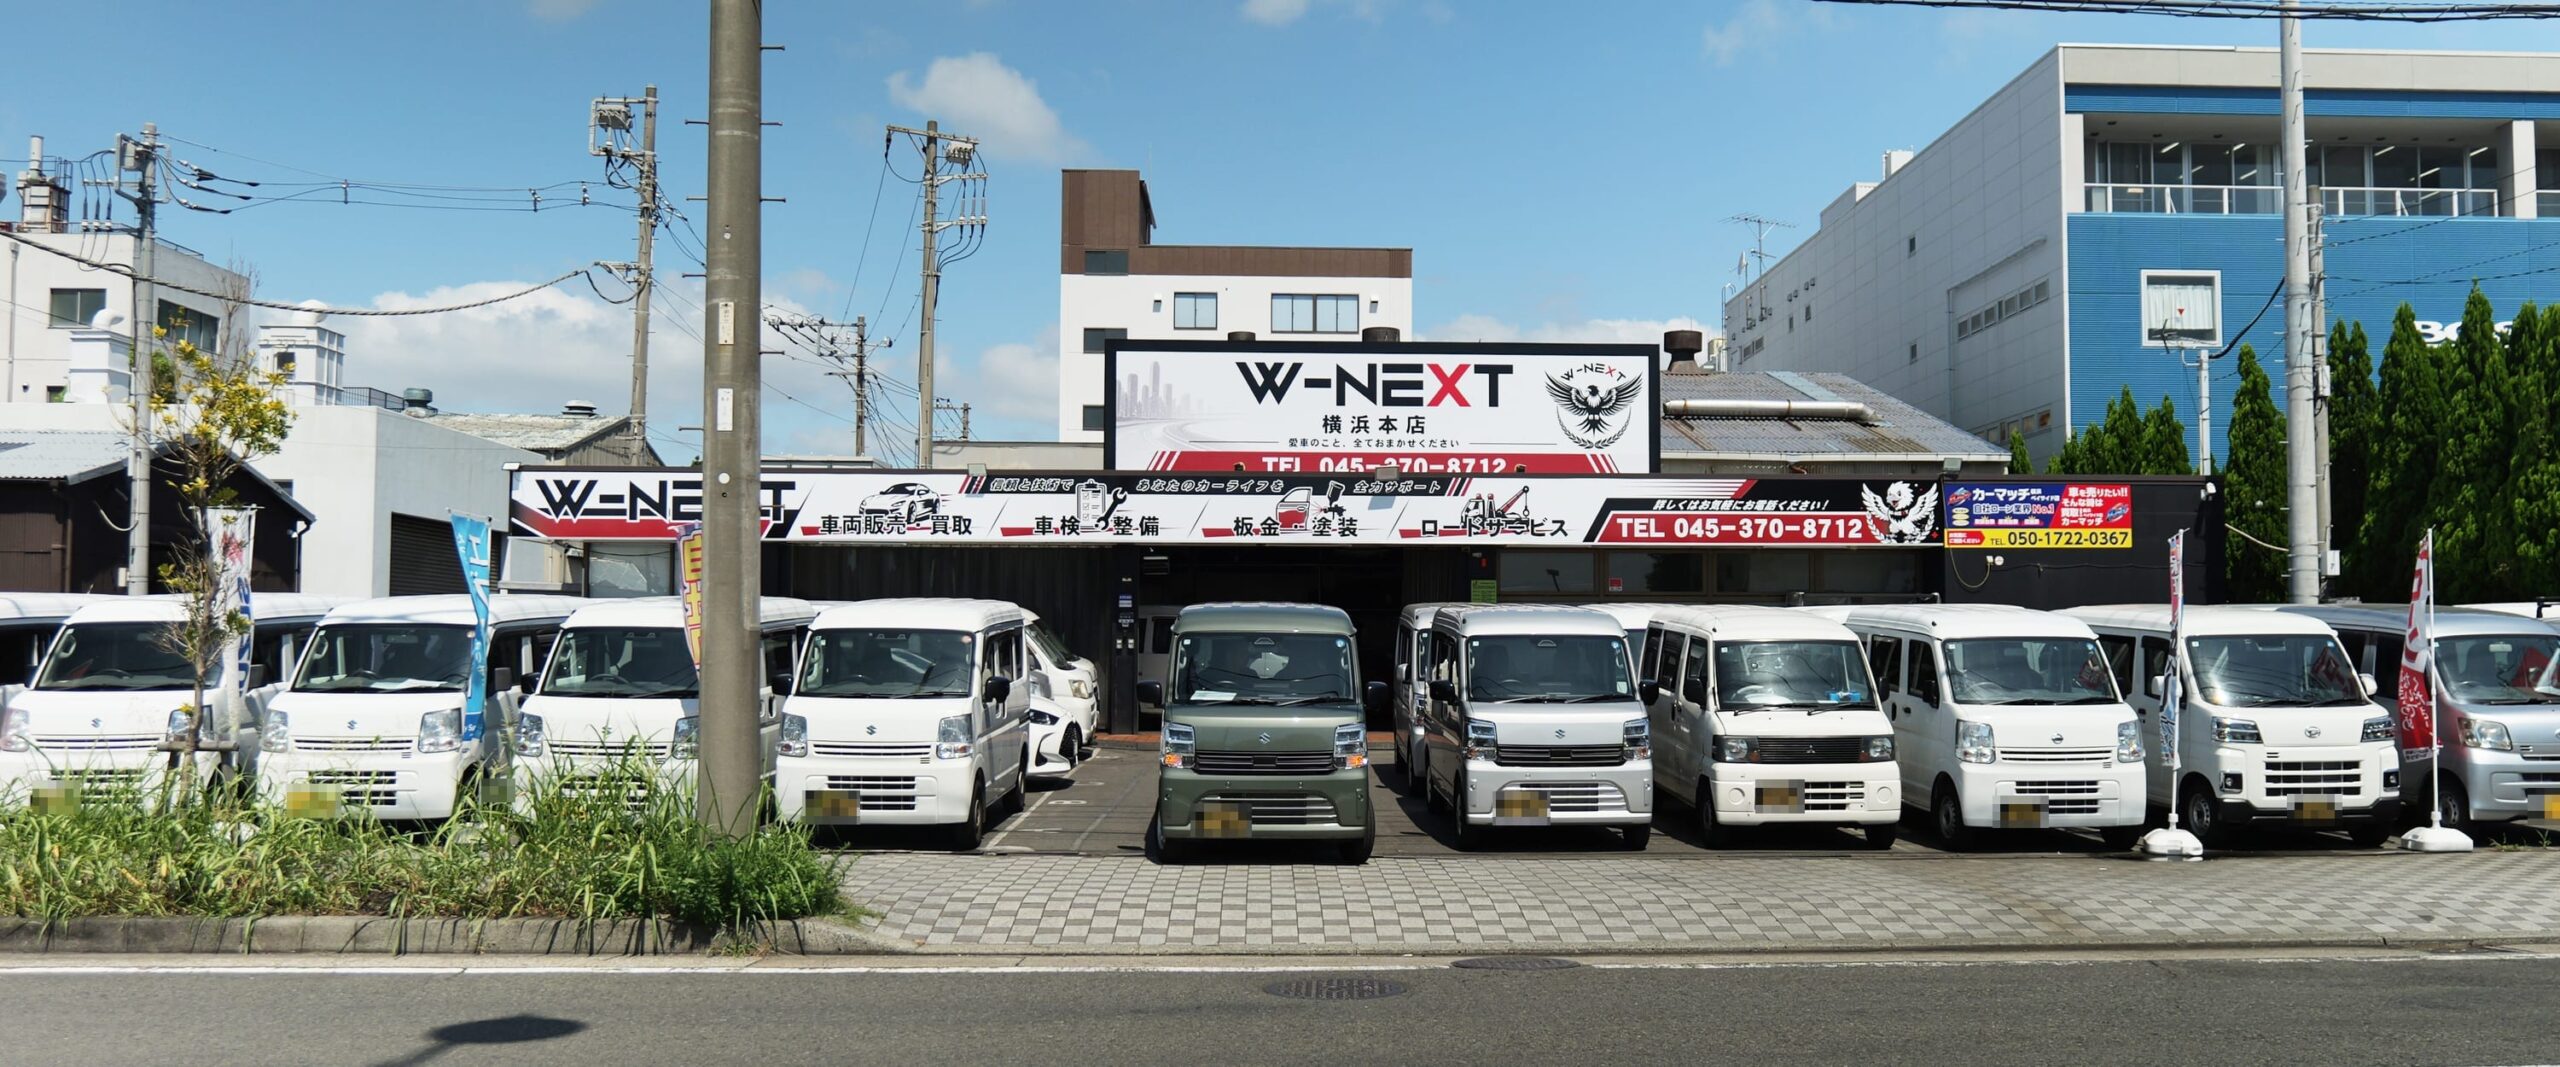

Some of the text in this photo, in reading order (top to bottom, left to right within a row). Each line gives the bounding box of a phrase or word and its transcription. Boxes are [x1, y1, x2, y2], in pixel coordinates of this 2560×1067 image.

[1561, 363, 1626, 382] W-NEXT
[1236, 362, 1513, 407] W-NEXT
[1322, 415, 1426, 435] 横浜本店
[990, 478, 1441, 494] 信頼と技術で あなたのカーライフを 全力サポート
[1972, 488, 2031, 501] カーマッチ
[535, 479, 796, 521] W-NET
[820, 515, 972, 536] 車両販売・買取
[1421, 517, 1569, 537] ロードサービス
[1617, 518, 1863, 538] TEL 045-370-8712
[2061, 518, 2104, 526] カーマッチ
[2008, 531, 2129, 545] 050-1722-0367
